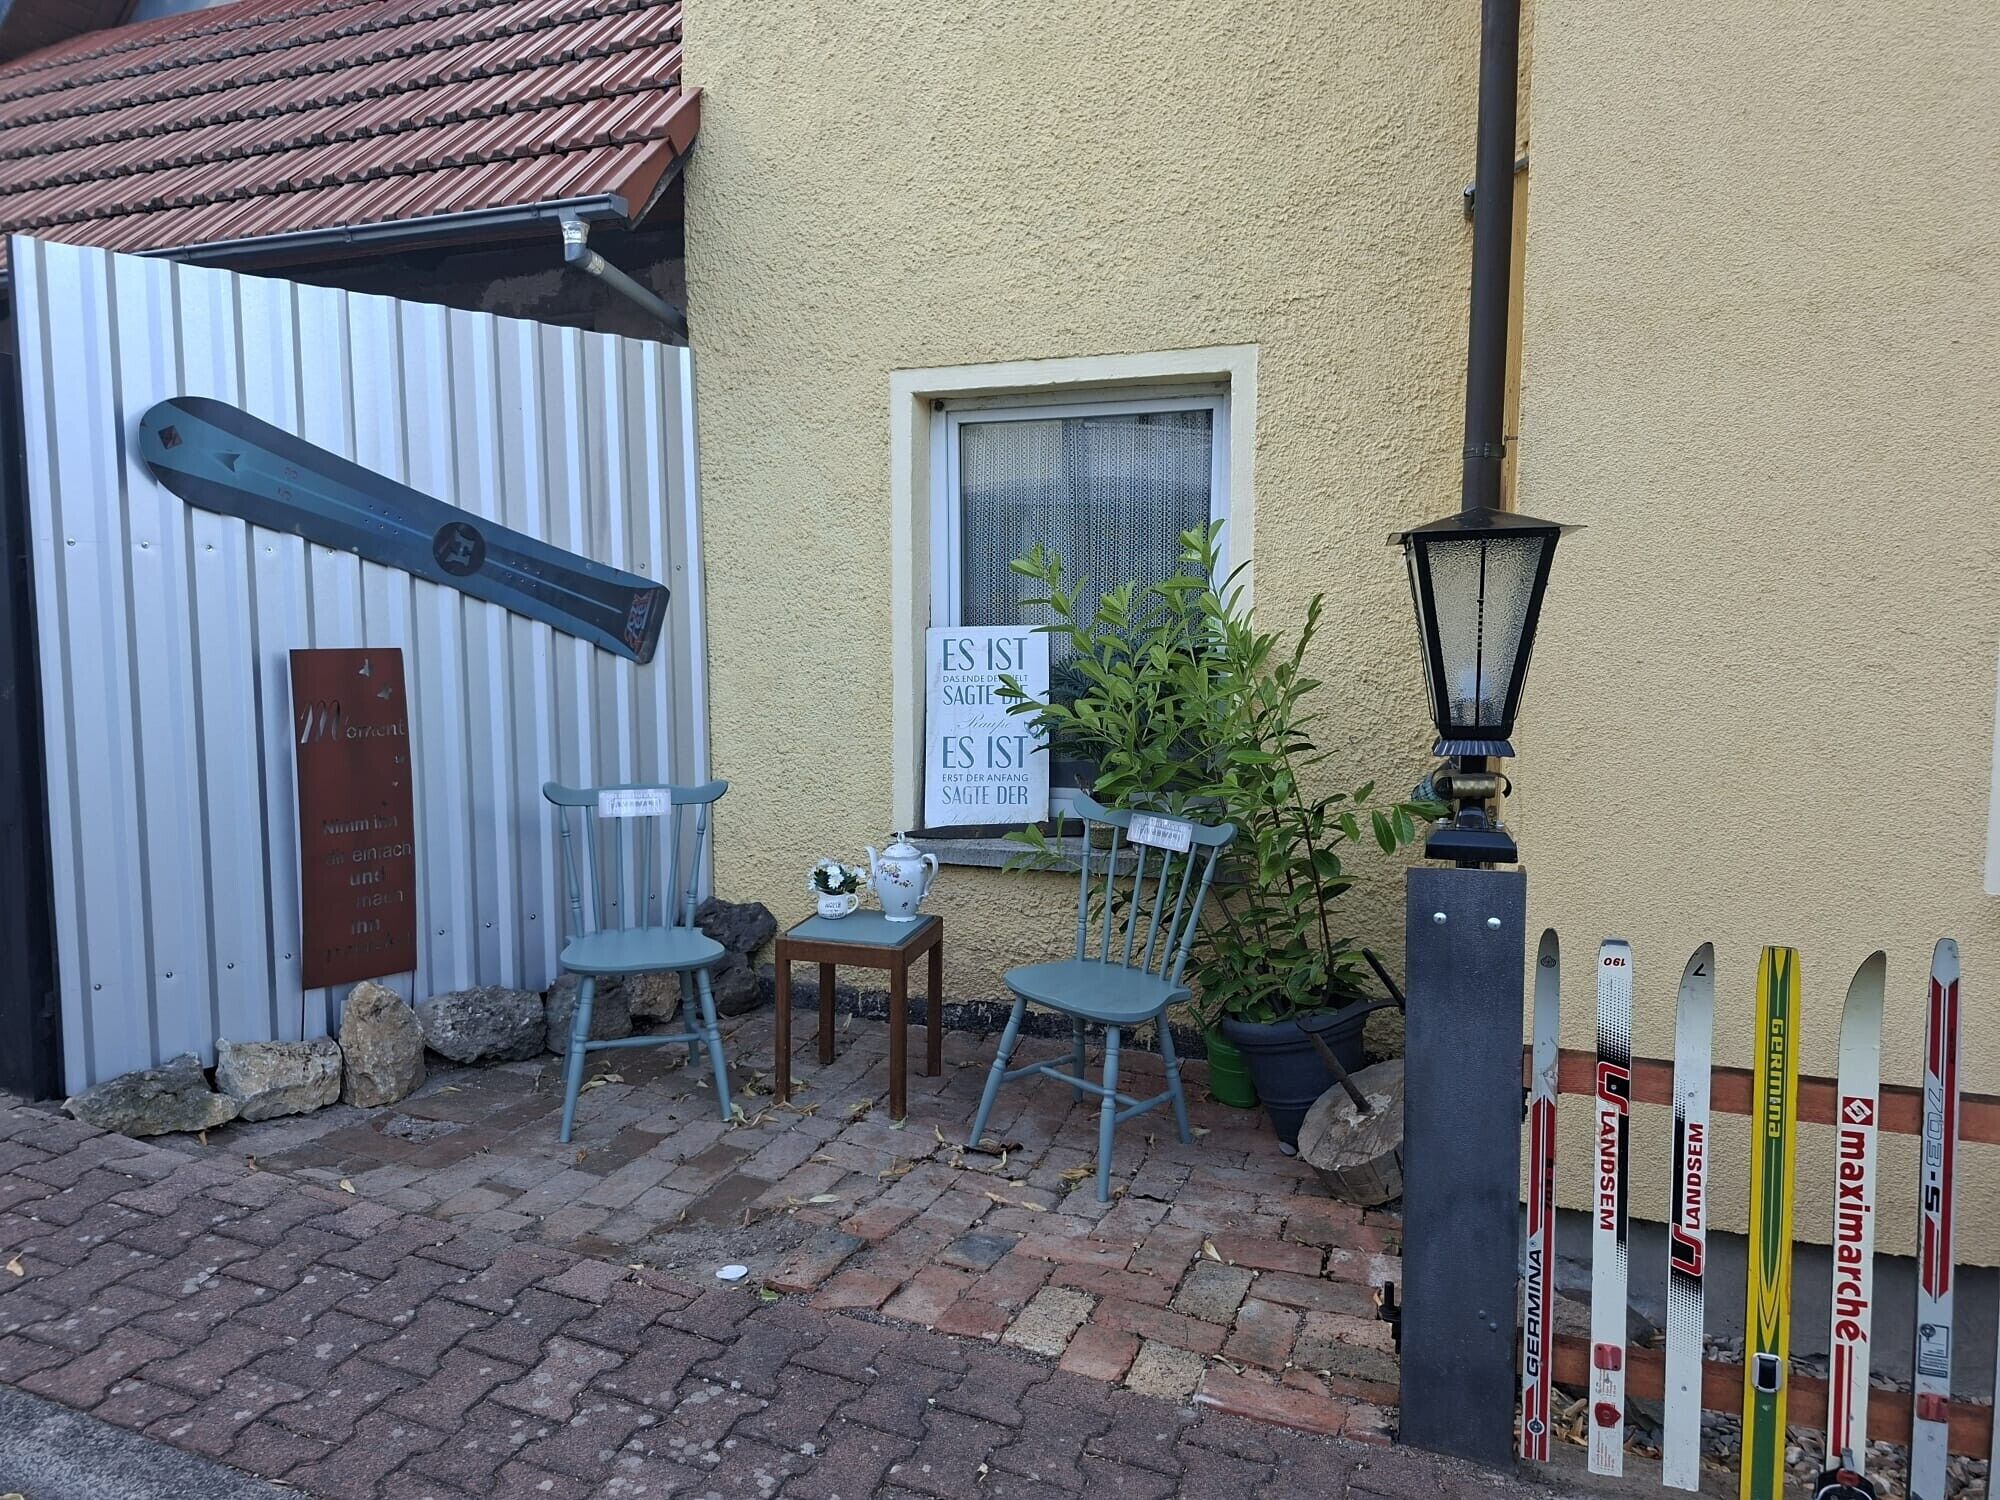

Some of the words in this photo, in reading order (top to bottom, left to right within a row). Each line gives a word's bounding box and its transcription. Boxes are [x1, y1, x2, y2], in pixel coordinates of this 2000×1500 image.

[942, 638, 975, 671] ES
[987, 638, 1028, 671] IST
[943, 675, 960, 683] DAS
[962, 675, 985, 683] ENDE
[987, 675, 1000, 683] DE
[943, 684, 995, 706] SAGTE
[300, 699, 406, 744] Moment
[942, 735, 975, 769] ES
[987, 735, 1029, 769] IST
[942, 774, 963, 783] ERST
[966, 774, 985, 782] DER
[987, 773, 1029, 782] ANFANG
[941, 785, 991, 805] SAGTE
[997, 785, 1029, 805] DER
[1603, 957, 1626, 967] 190
[1600, 1110, 1616, 1231] LANDSEM
[1685, 1122, 1704, 1230] LANDSEM
[1835, 1130, 1870, 1343] maximarché
[1526, 1249, 1541, 1377] GERMINA
